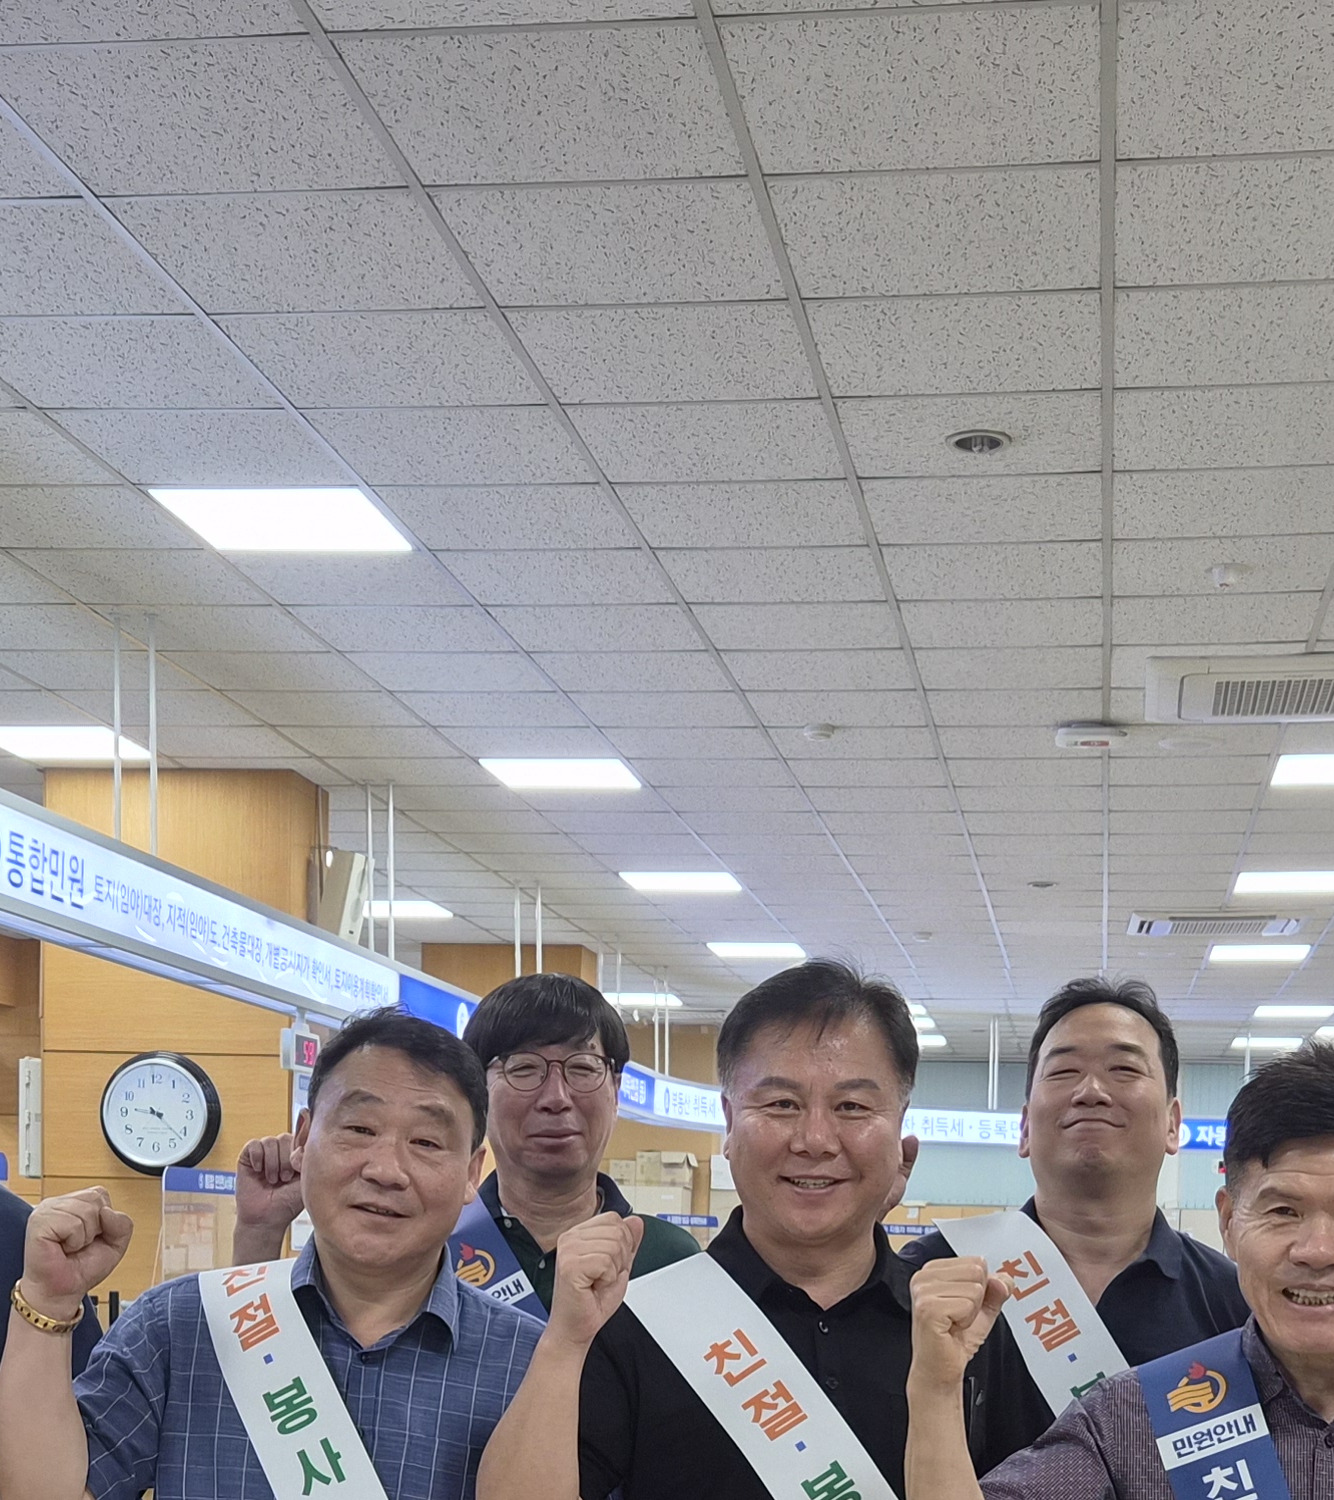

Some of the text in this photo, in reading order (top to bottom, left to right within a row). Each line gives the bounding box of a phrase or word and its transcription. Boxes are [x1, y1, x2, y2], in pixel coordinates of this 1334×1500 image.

[5, 830, 85, 910] 통합민원
[138, 1078, 145, 1088] 11
[151, 1073, 162, 1084] 12
[171, 1079, 176, 1089] 1
[125, 1090, 134, 1101] 10
[182, 1092, 190, 1103] 2
[120, 1106, 128, 1117] 9
[185, 1109, 194, 1120] 3
[124, 1124, 133, 1134] 8
[180, 1125, 187, 1137] 4
[136, 1137, 144, 1147] 7
[152, 1141, 160, 1152] 6
[168, 1138, 177, 1149] 5
[1171, 1412, 1259, 1462] 민원안내
